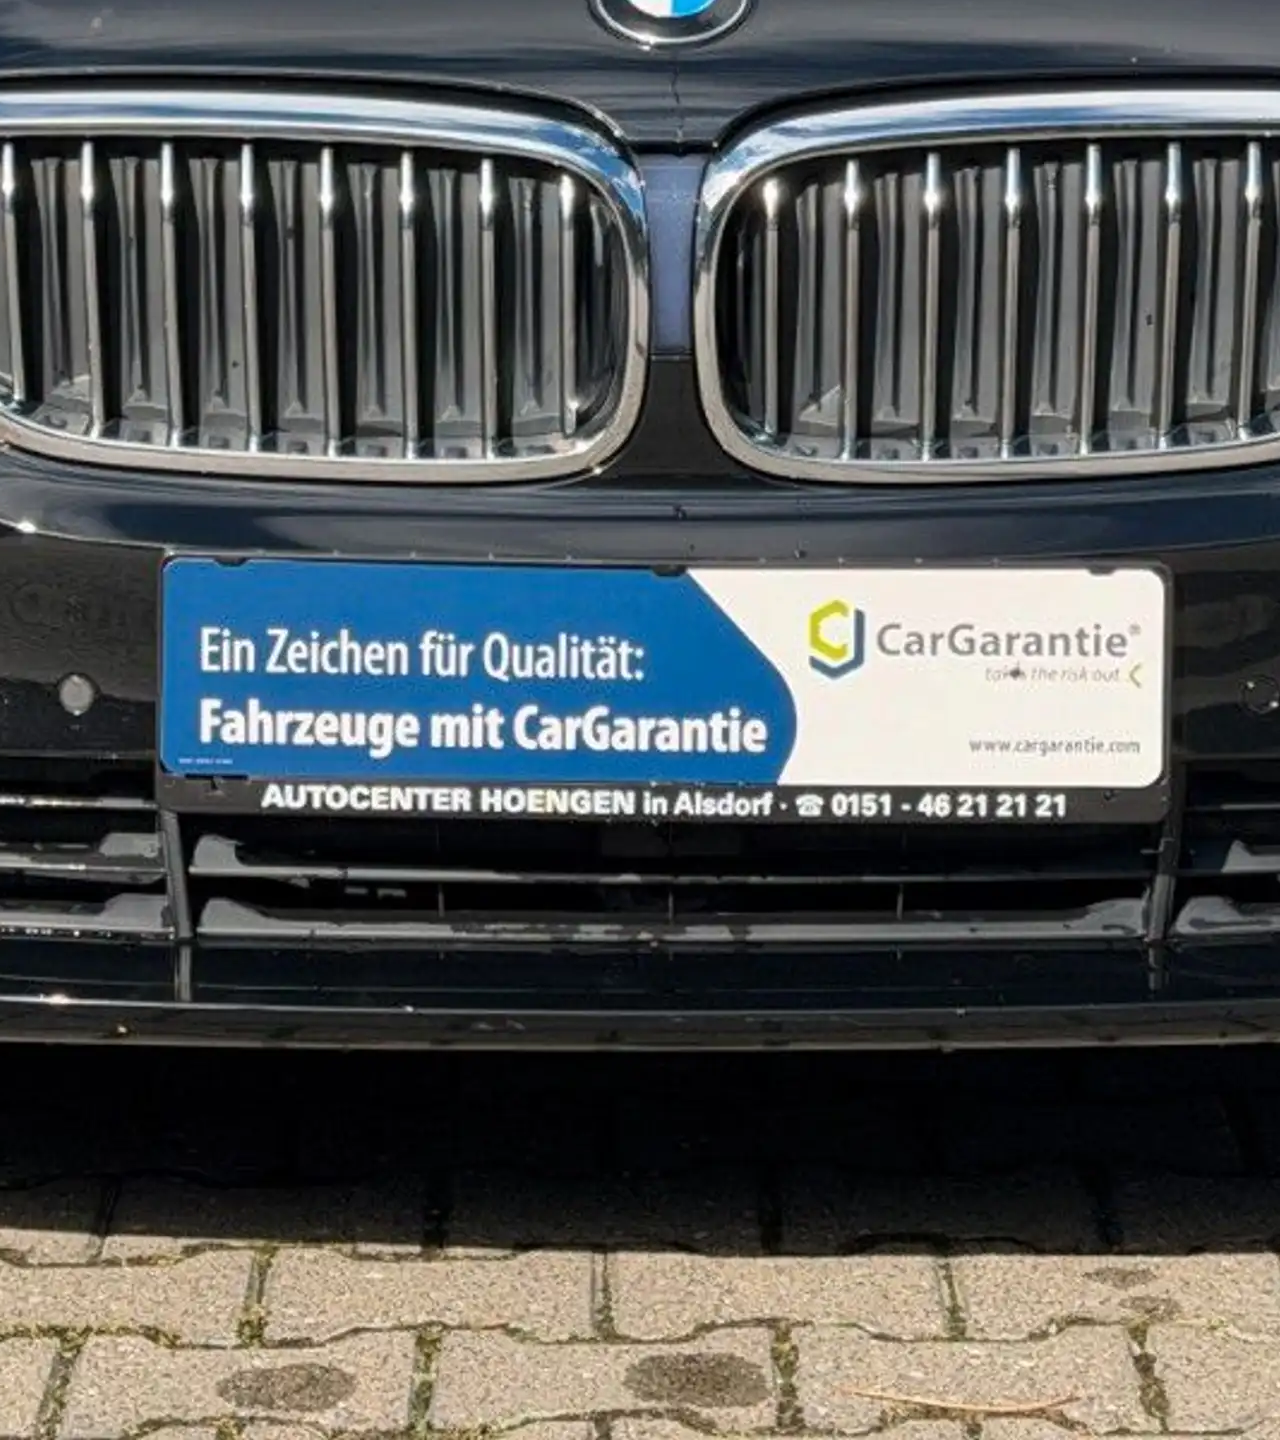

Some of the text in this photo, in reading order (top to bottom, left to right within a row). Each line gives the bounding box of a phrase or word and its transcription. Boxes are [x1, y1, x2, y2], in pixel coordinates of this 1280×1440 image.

[200, 626, 645, 681] Ein Zeichen für Qualität:
[200, 697, 768, 759] Fahrzeuge mit CarGarantie
[969, 736, 1141, 757] www.cargarantie.com
[261, 783, 471, 814] AUTOCENTER
[481, 787, 634, 816] HOENGEN
[643, 789, 667, 815] in
[674, 790, 773, 817] Alsdorf
[831, 793, 892, 818] 0151
[917, 793, 950, 818] 46
[957, 793, 988, 818] 21
[995, 793, 1027, 818] 21
[1035, 793, 1067, 818] 21
